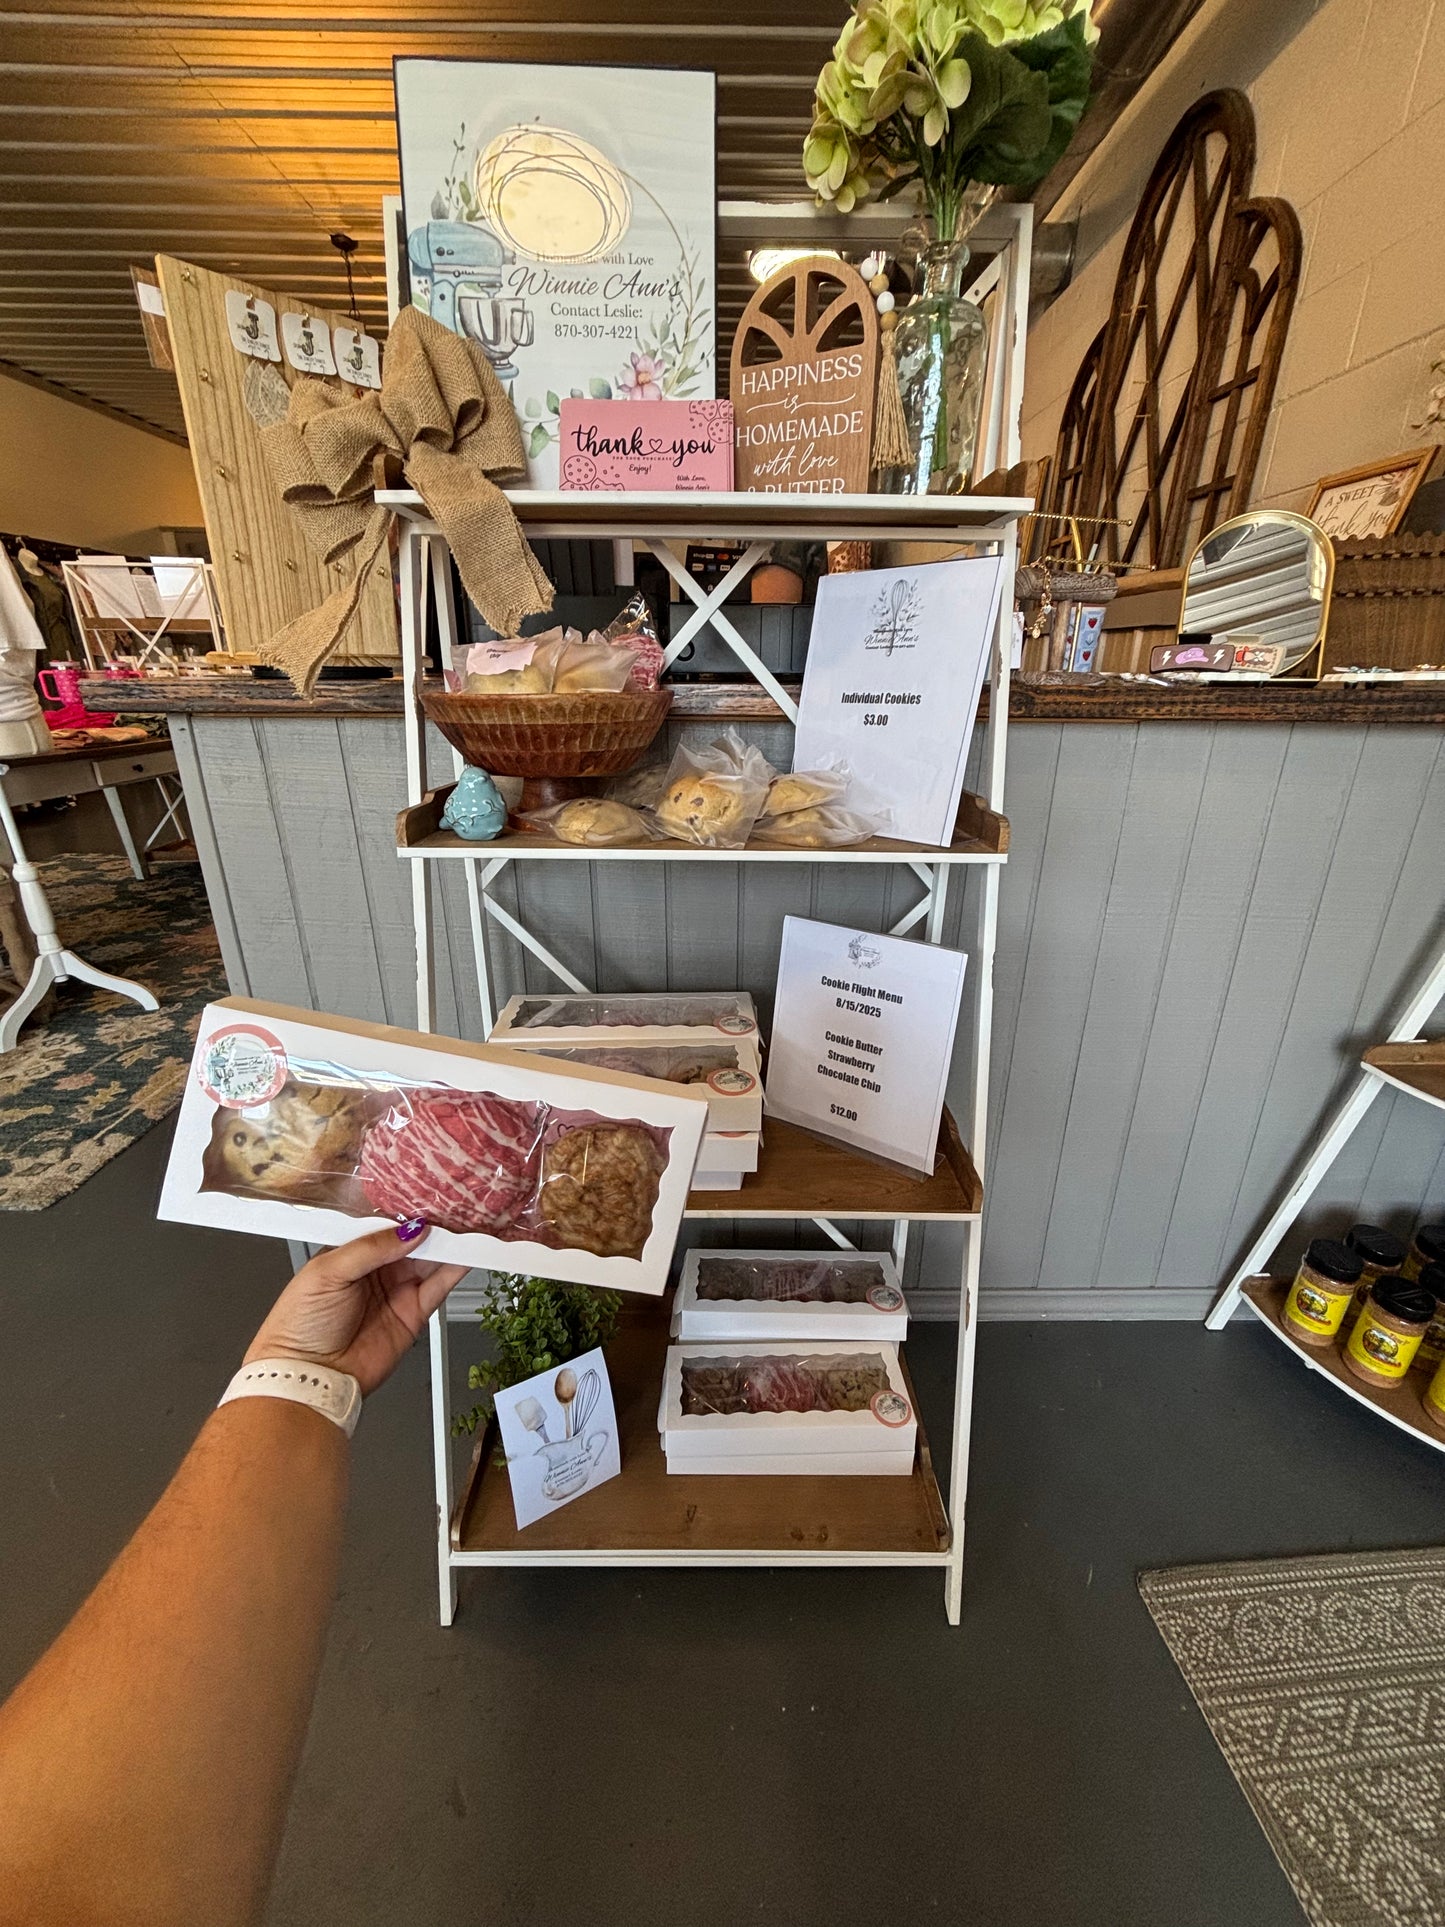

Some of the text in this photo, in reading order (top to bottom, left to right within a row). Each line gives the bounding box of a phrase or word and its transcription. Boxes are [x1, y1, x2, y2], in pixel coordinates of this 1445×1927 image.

[602, 252, 625, 266] with
[628, 253, 654, 266] Love
[508, 266, 683, 300] Winnie Ann's
[550, 302, 643, 318] Contact Leslie:
[554, 325, 639, 339] 870-307-4221
[741, 354, 863, 395] HAPPINESS
[736, 410, 864, 448] HOMEMADE
[571, 423, 717, 468] thank you
[629, 464, 652, 475] Enjoy!
[753, 442, 839, 477] with love
[1324, 485, 1376, 508] A SWEET
[841, 692, 922, 705] Individual Cookies
[863, 713, 889, 726] $3.00
[821, 975, 904, 1005] Cookie Flight Menu
[835, 997, 882, 1018] 8/15/2025
[825, 1030, 884, 1056] Cookie Butter
[827, 1049, 876, 1073] Strawberry
[817, 1064, 882, 1093] Chocolate Chip
[830, 1103, 858, 1122] $12.00
